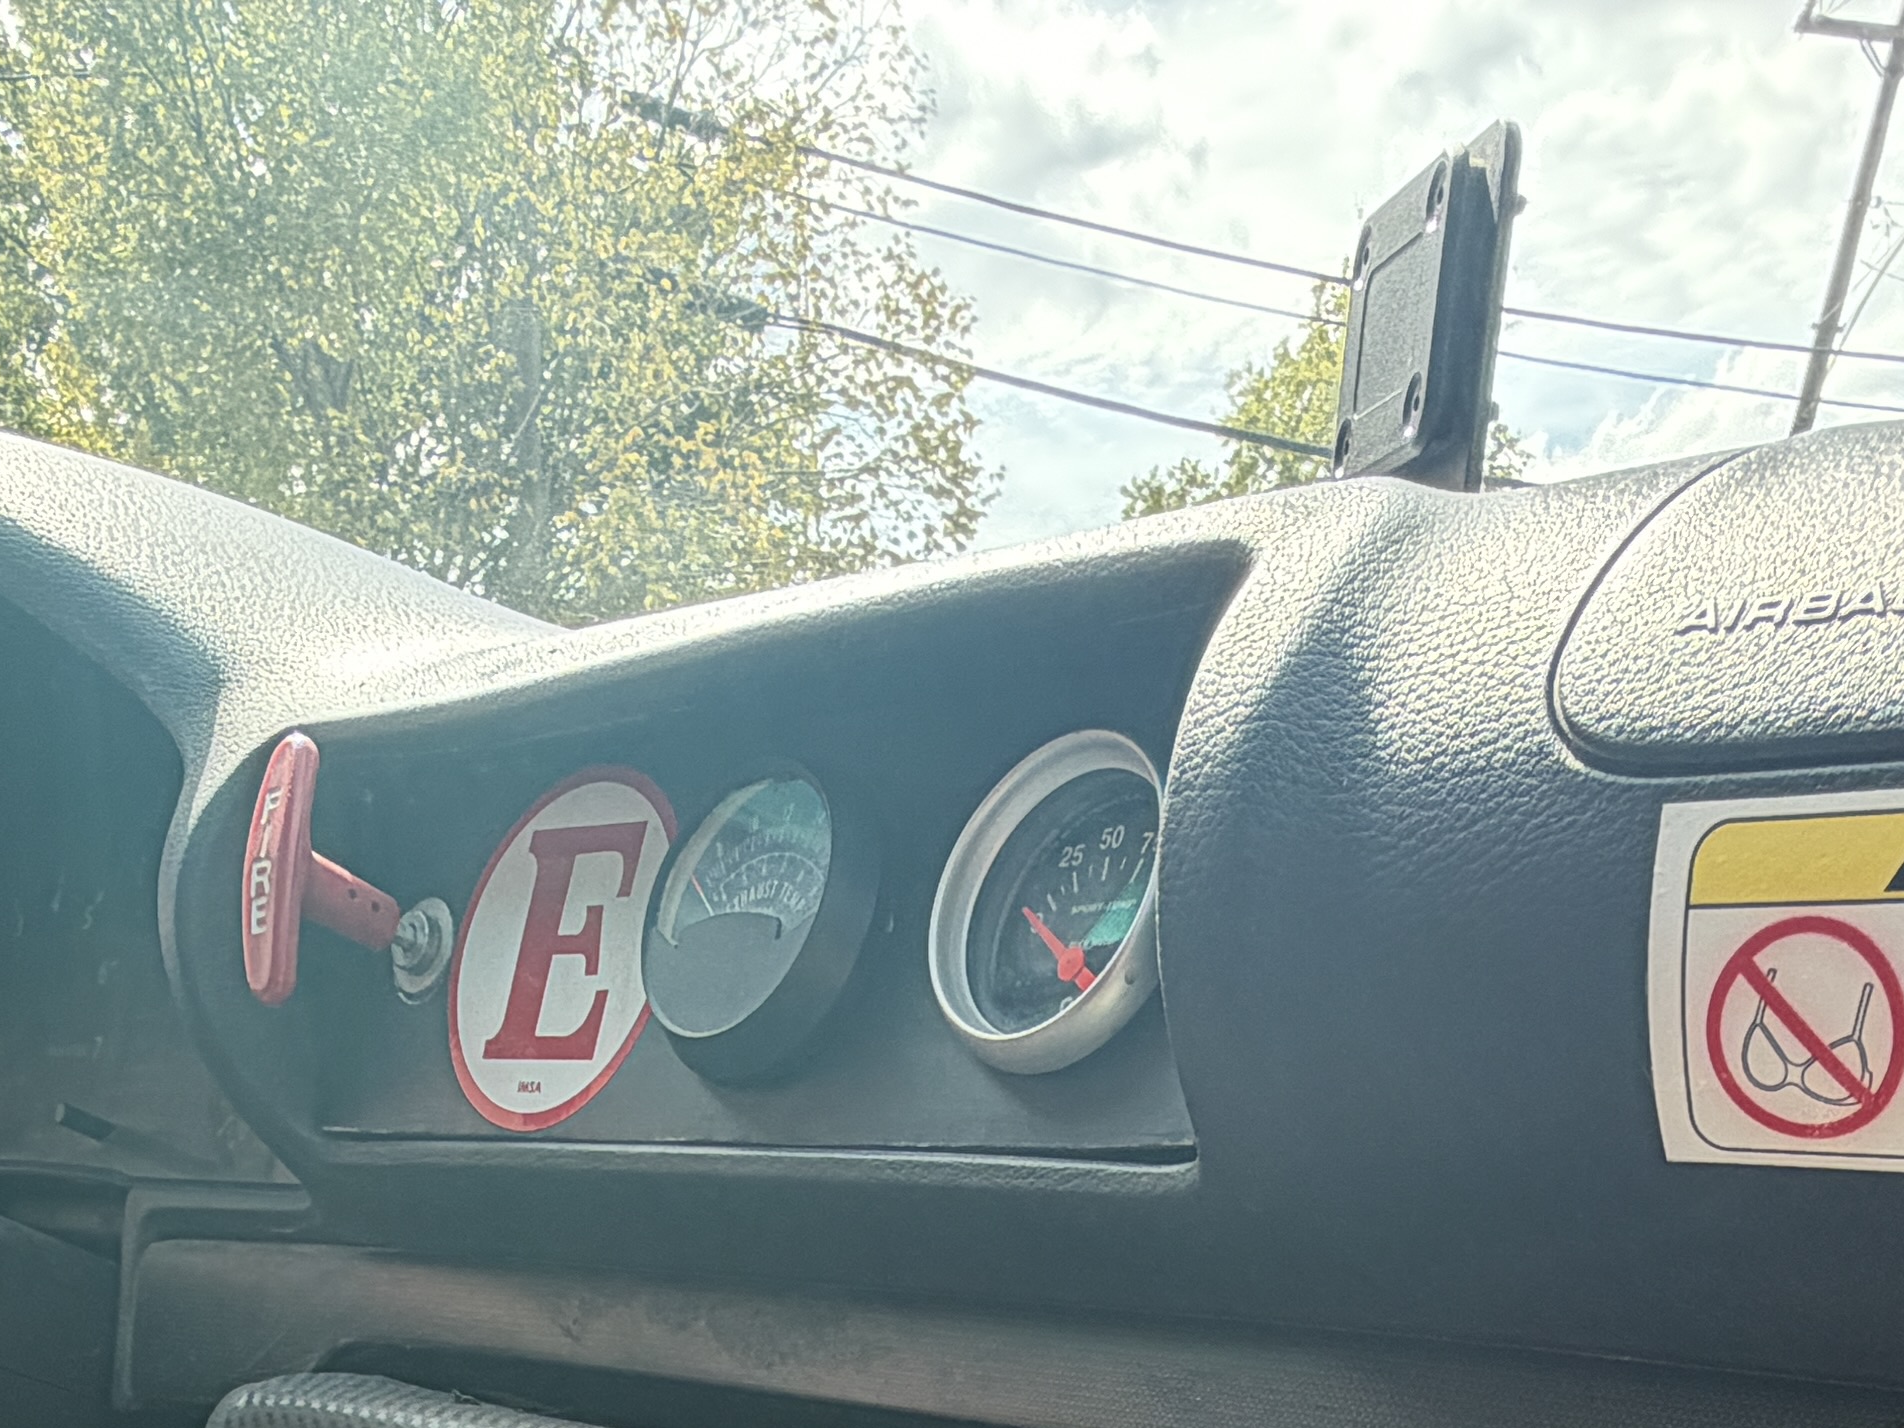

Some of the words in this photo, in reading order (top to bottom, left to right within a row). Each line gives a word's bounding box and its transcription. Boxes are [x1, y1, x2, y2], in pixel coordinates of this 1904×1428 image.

[250, 786, 283, 936] FIRE
[1058, 844, 1086, 868] 25
[1099, 825, 1126, 851] 50
[1141, 831, 1160, 855] 7
[482, 820, 649, 1061] E
